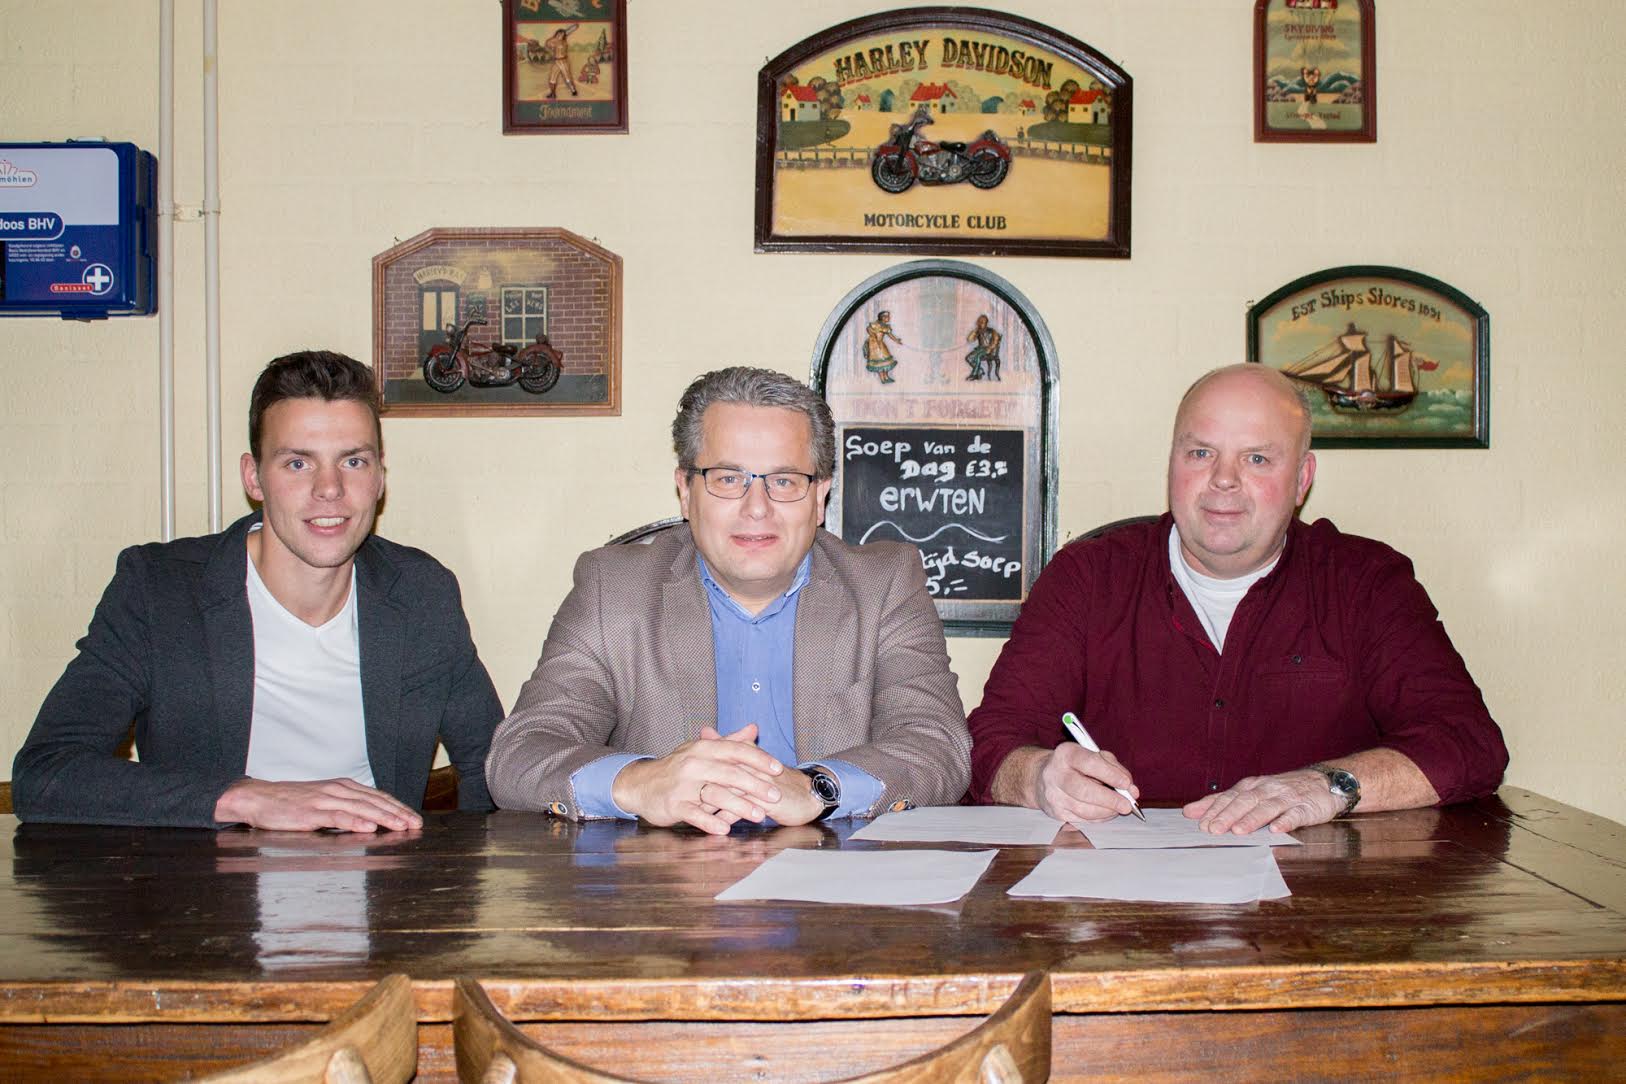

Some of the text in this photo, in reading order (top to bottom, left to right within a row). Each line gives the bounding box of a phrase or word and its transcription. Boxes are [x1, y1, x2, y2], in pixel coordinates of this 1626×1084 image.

[835, 38, 1054, 89] HARLEY DAVIDSON
[28, 218, 55, 230] BHV
[864, 213, 1007, 230] MOTORCYCLE CLUB
[1291, 299, 1316, 321] EST
[1367, 287, 1416, 313] Stores
[845, 435, 911, 462] Soep
[967, 435, 992, 453] de
[900, 459, 956, 482] Dag
